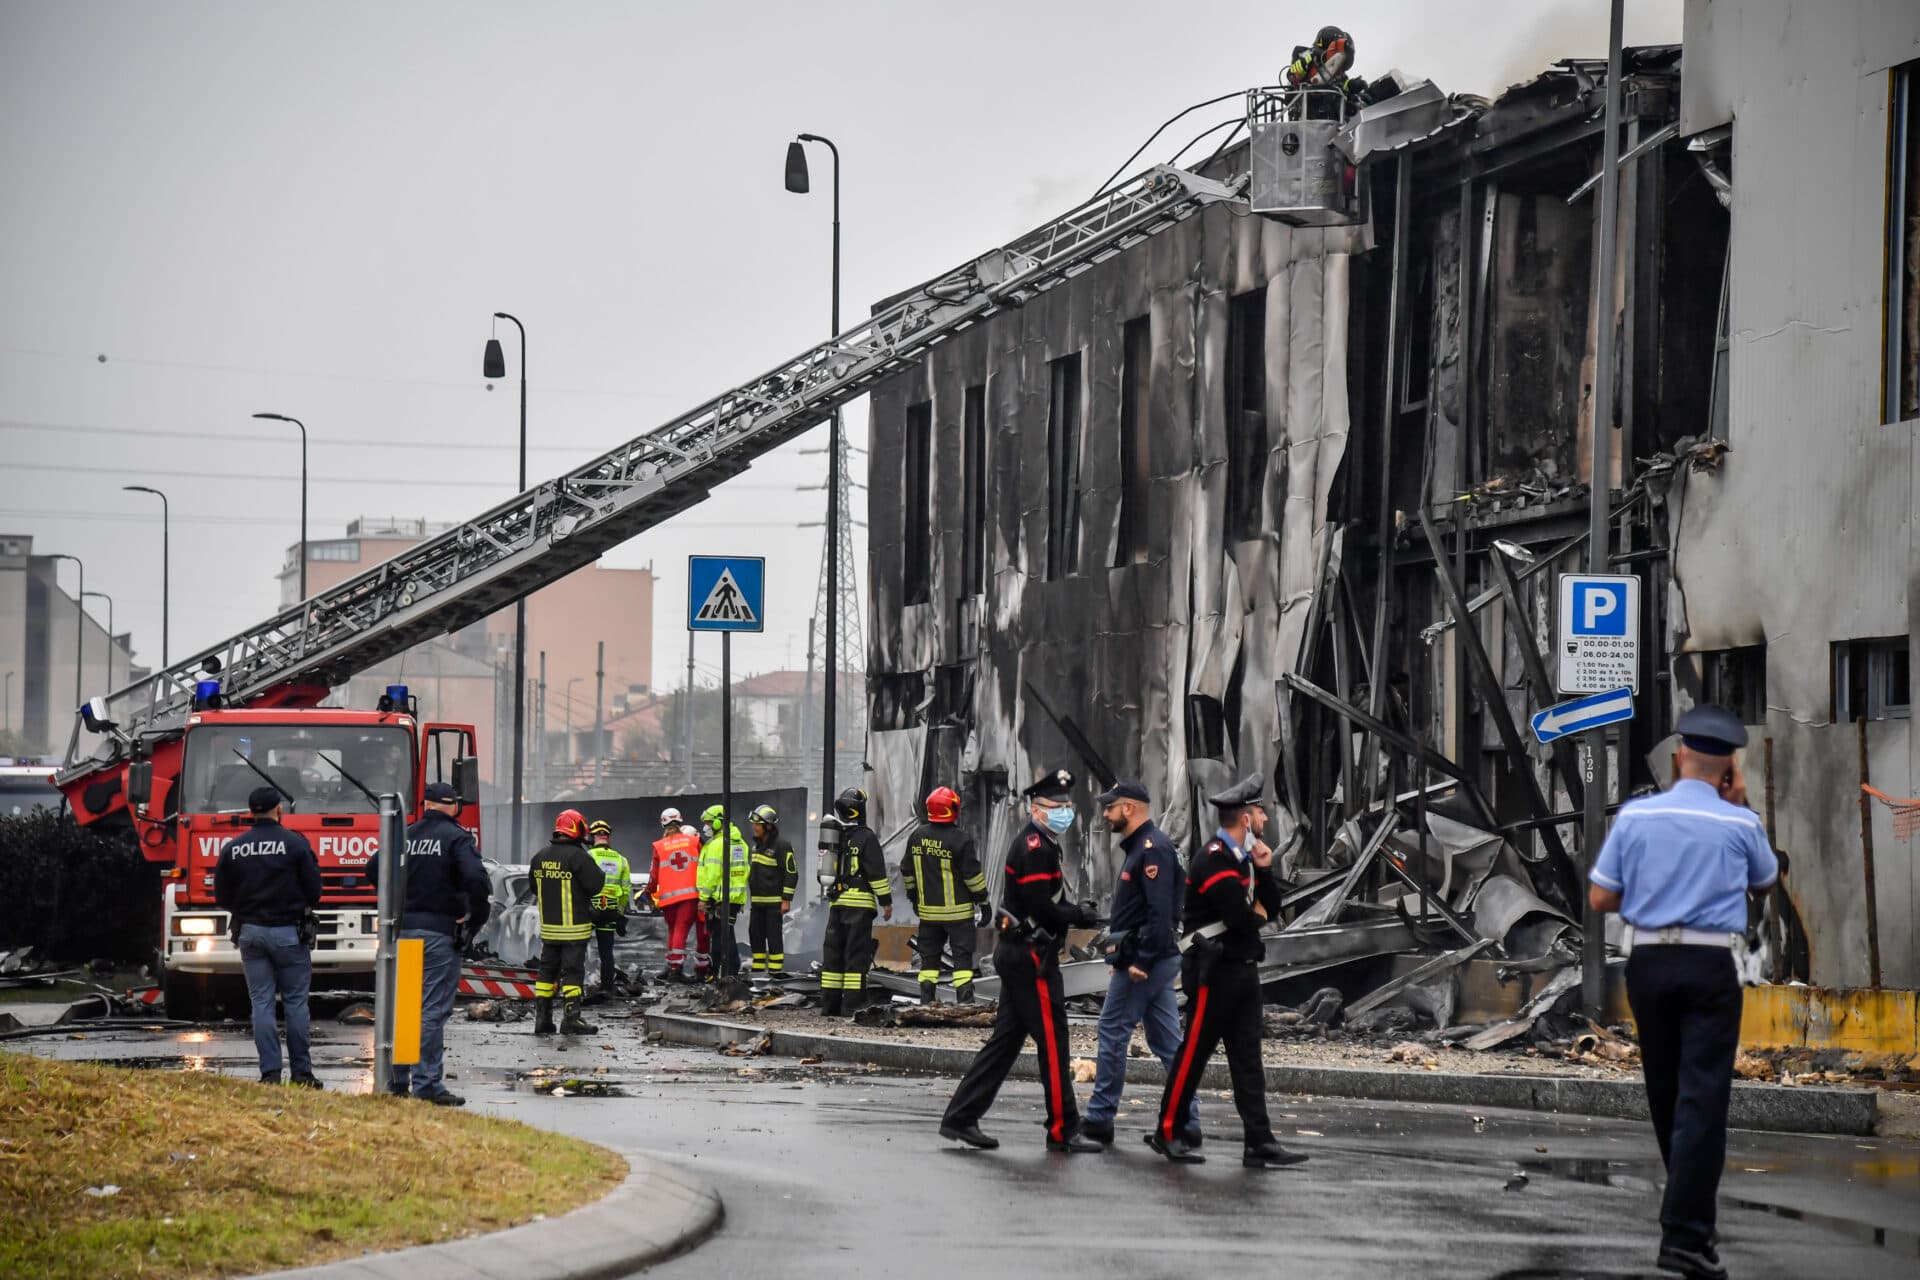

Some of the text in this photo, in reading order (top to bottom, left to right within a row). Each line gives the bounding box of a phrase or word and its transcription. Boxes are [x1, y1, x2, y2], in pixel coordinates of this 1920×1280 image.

[1585, 588, 1617, 628] P
[1586, 746, 1594, 783] 129
[921, 838, 942, 849] VIGILI
[231, 841, 287, 860] POLIZIA
[911, 846, 923, 855] DEL
[541, 861, 561, 870] VIGILI
[533, 869, 573, 880] DEL FUOCO
